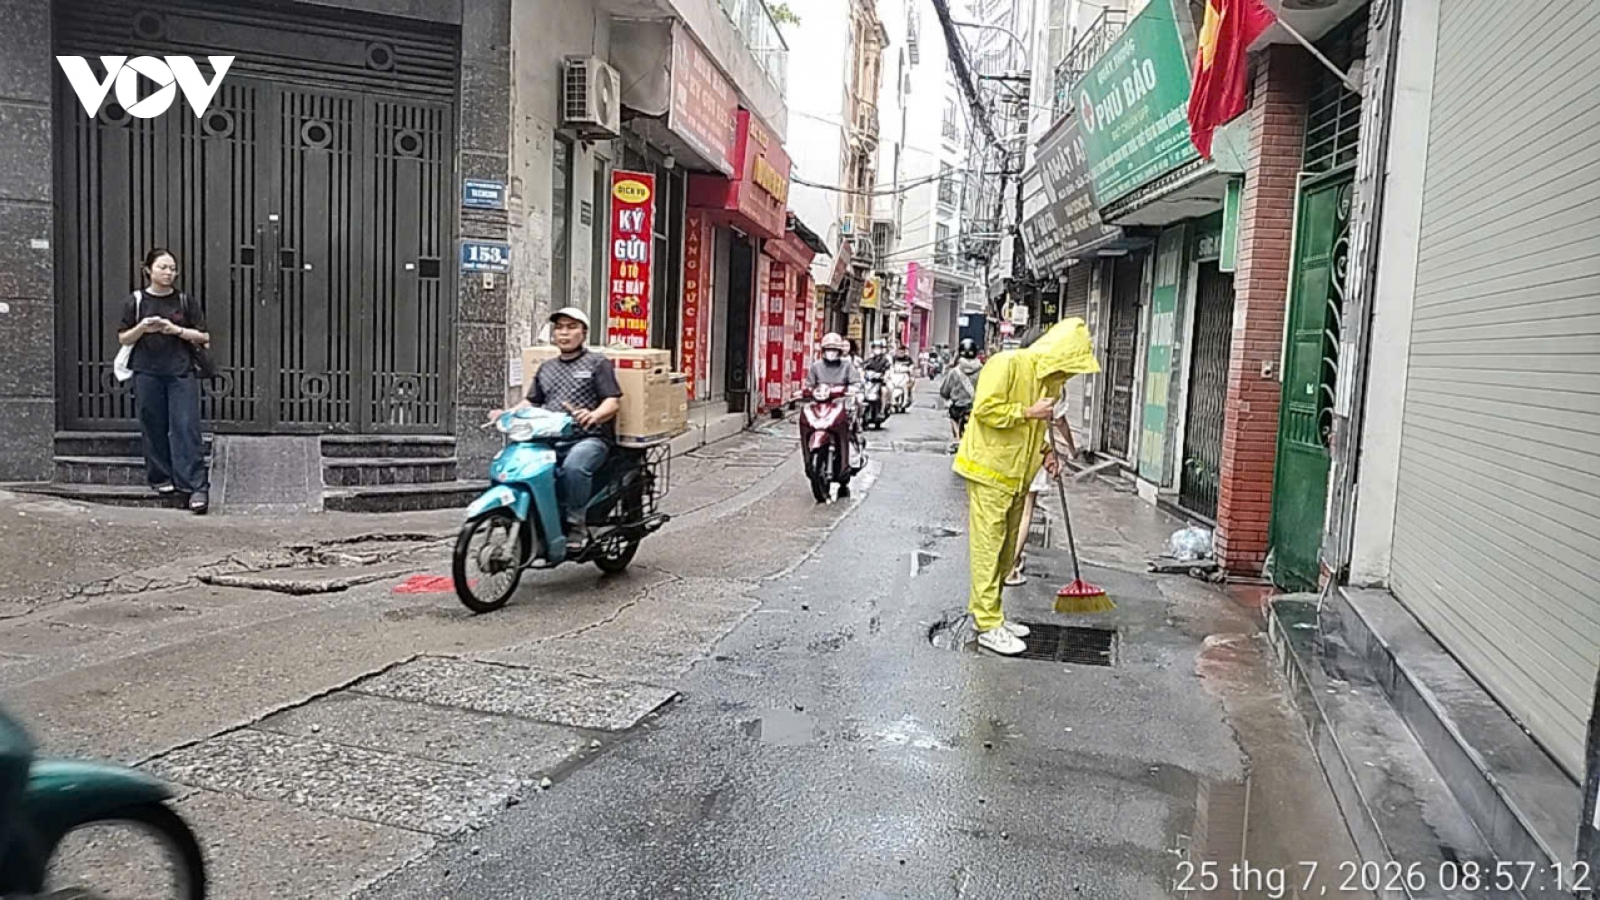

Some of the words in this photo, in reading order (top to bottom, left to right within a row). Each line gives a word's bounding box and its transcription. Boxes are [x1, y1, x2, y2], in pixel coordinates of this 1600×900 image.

[1095, 83, 1124, 131] PHÚ
[1122, 58, 1157, 108] BẢO
[1047, 145, 1075, 183] NHẬT
[619, 207, 645, 232] KÝ
[469, 246, 502, 263] 153
[615, 235, 647, 261] GỬI
[620, 261, 627, 278] Ô
[628, 262, 639, 278] TÔ
[612, 279, 625, 294] XE
[625, 278, 646, 296] MÁY
